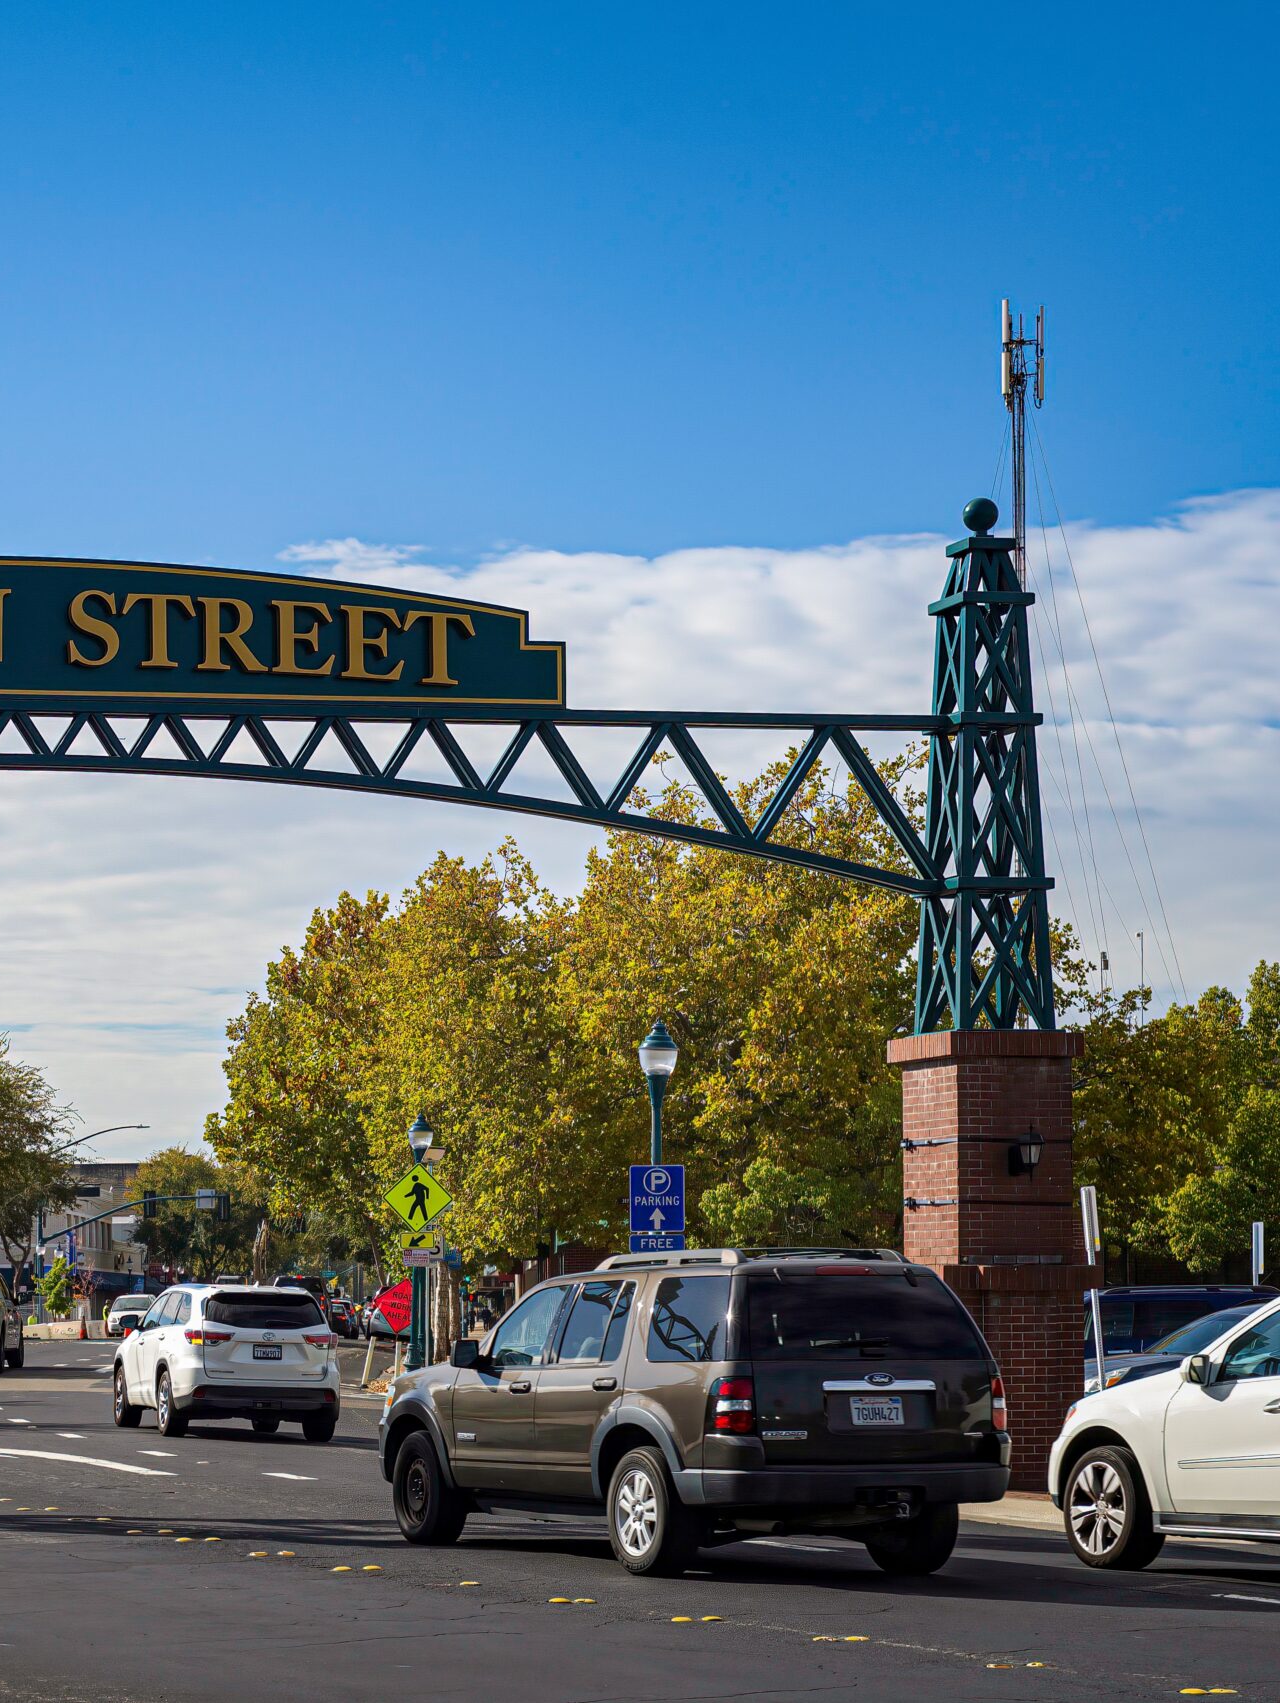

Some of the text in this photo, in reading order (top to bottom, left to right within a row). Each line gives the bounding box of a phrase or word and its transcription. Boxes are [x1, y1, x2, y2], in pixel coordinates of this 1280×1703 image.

[67, 589, 476, 687] STREET
[651, 1172, 667, 1191] P
[634, 1195, 680, 1206] PARKING
[641, 1238, 674, 1249] FREE
[854, 1407, 900, 1421] 7GUH427
